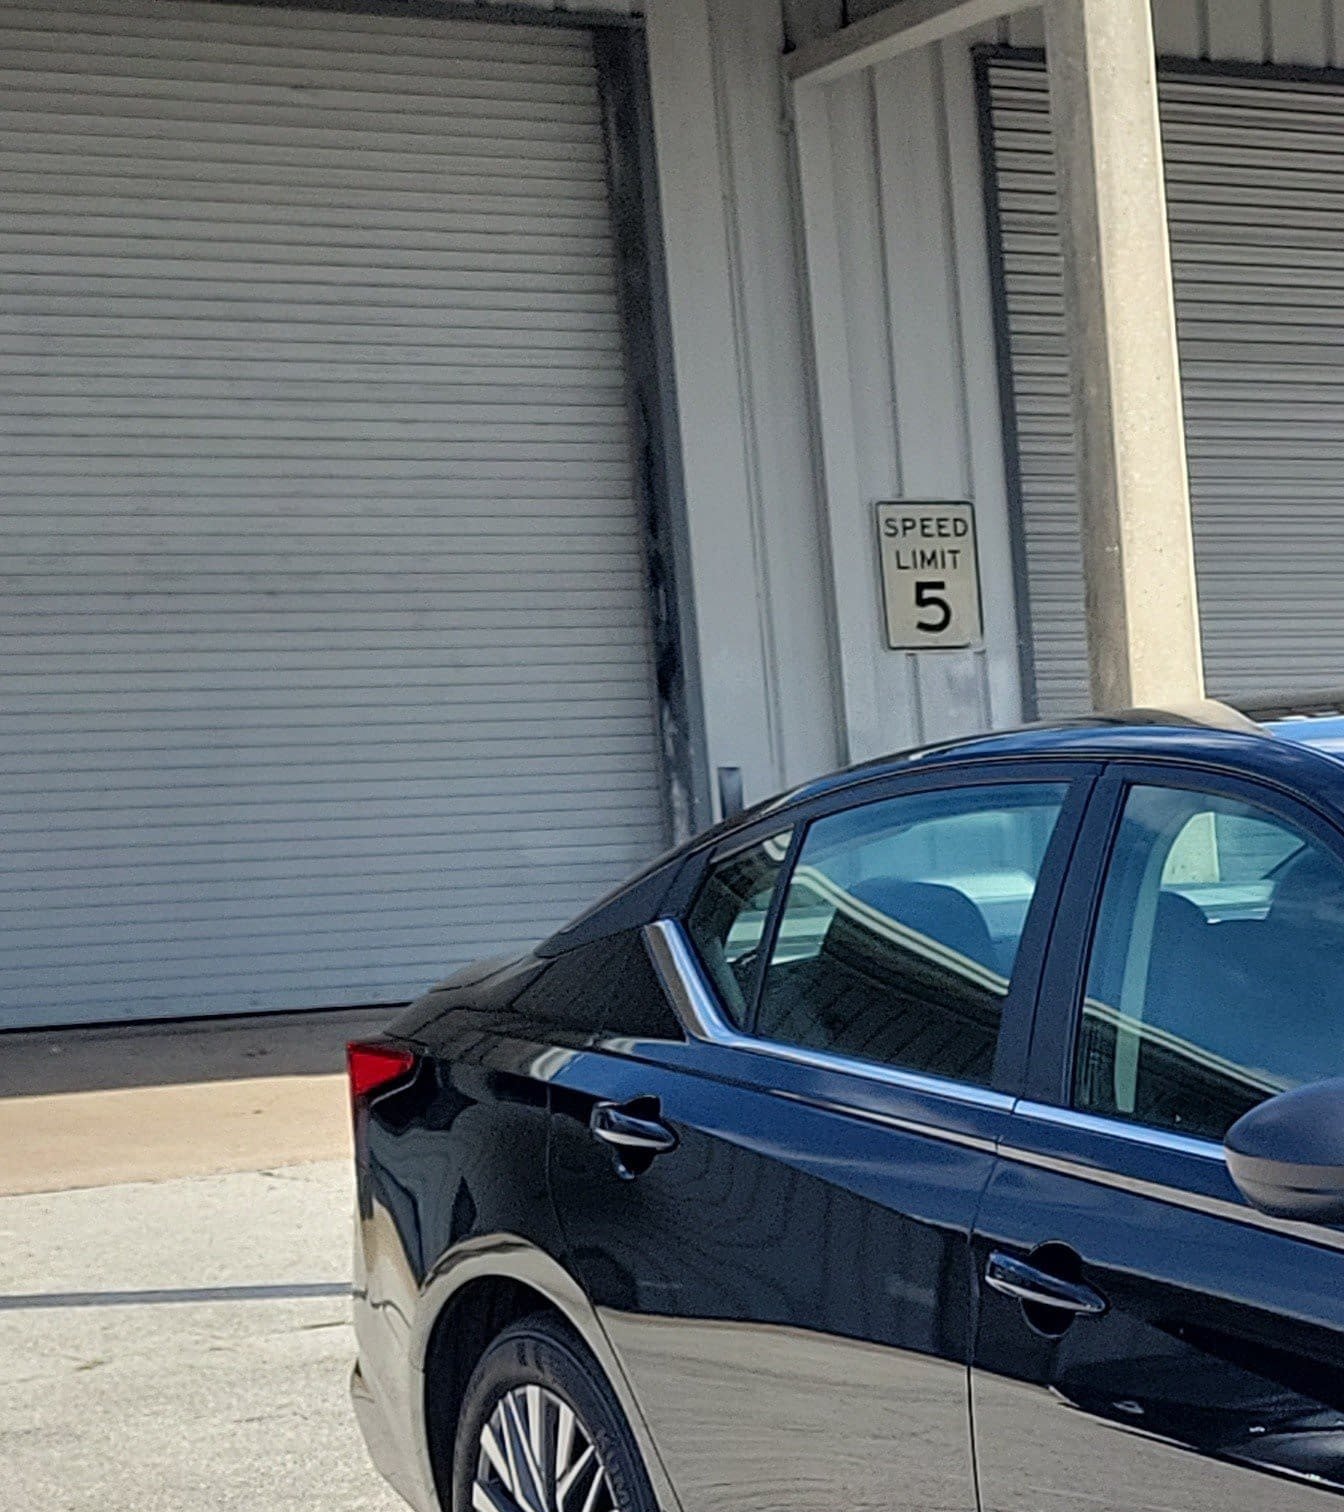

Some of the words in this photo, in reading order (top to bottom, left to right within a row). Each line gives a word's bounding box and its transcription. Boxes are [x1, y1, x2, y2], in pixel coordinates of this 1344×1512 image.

[884, 517, 969, 538] SPEED
[896, 549, 961, 570] LIMIT
[915, 581, 952, 632] 5
